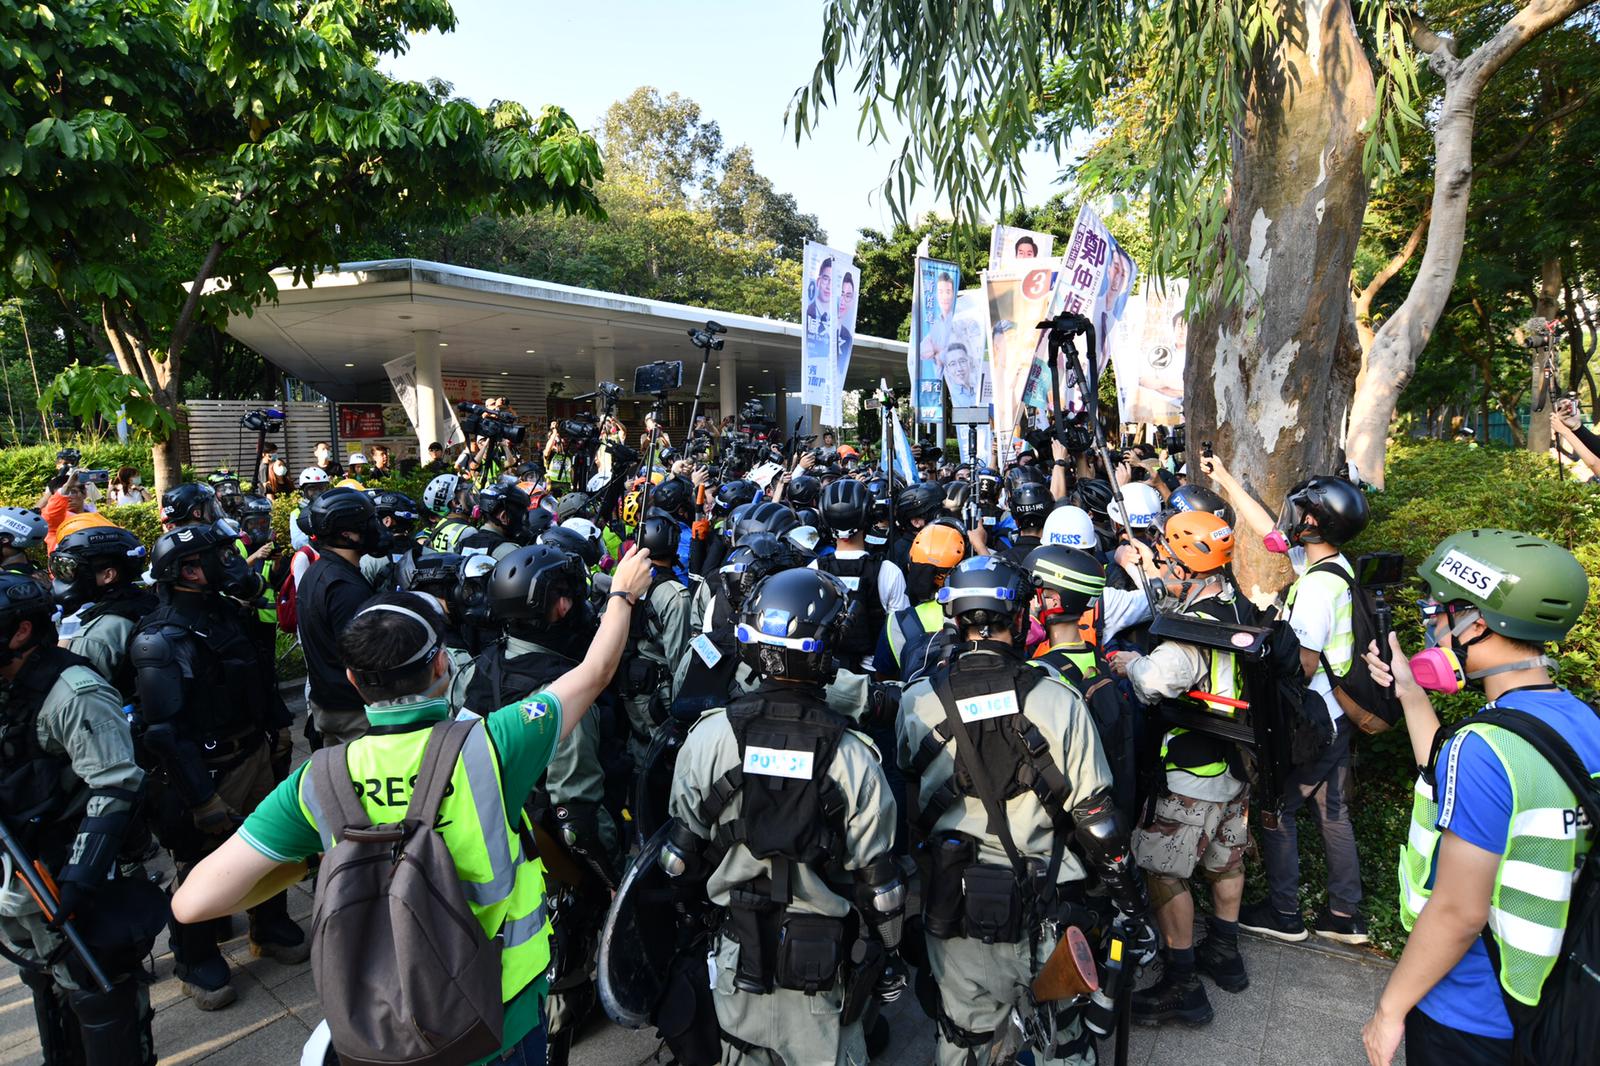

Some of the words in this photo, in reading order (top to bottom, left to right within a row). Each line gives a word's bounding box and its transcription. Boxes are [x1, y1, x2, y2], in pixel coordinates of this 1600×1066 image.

[1029, 272, 1046, 294] 3
[1152, 347, 1168, 367] 2
[1173, 496, 1193, 513] PRE
[1129, 512, 1159, 524] PRES
[1050, 532, 1081, 545] PRESS
[1441, 556, 1492, 590] PRESS
[964, 696, 1012, 716] OICE
[750, 753, 806, 771] POCE
